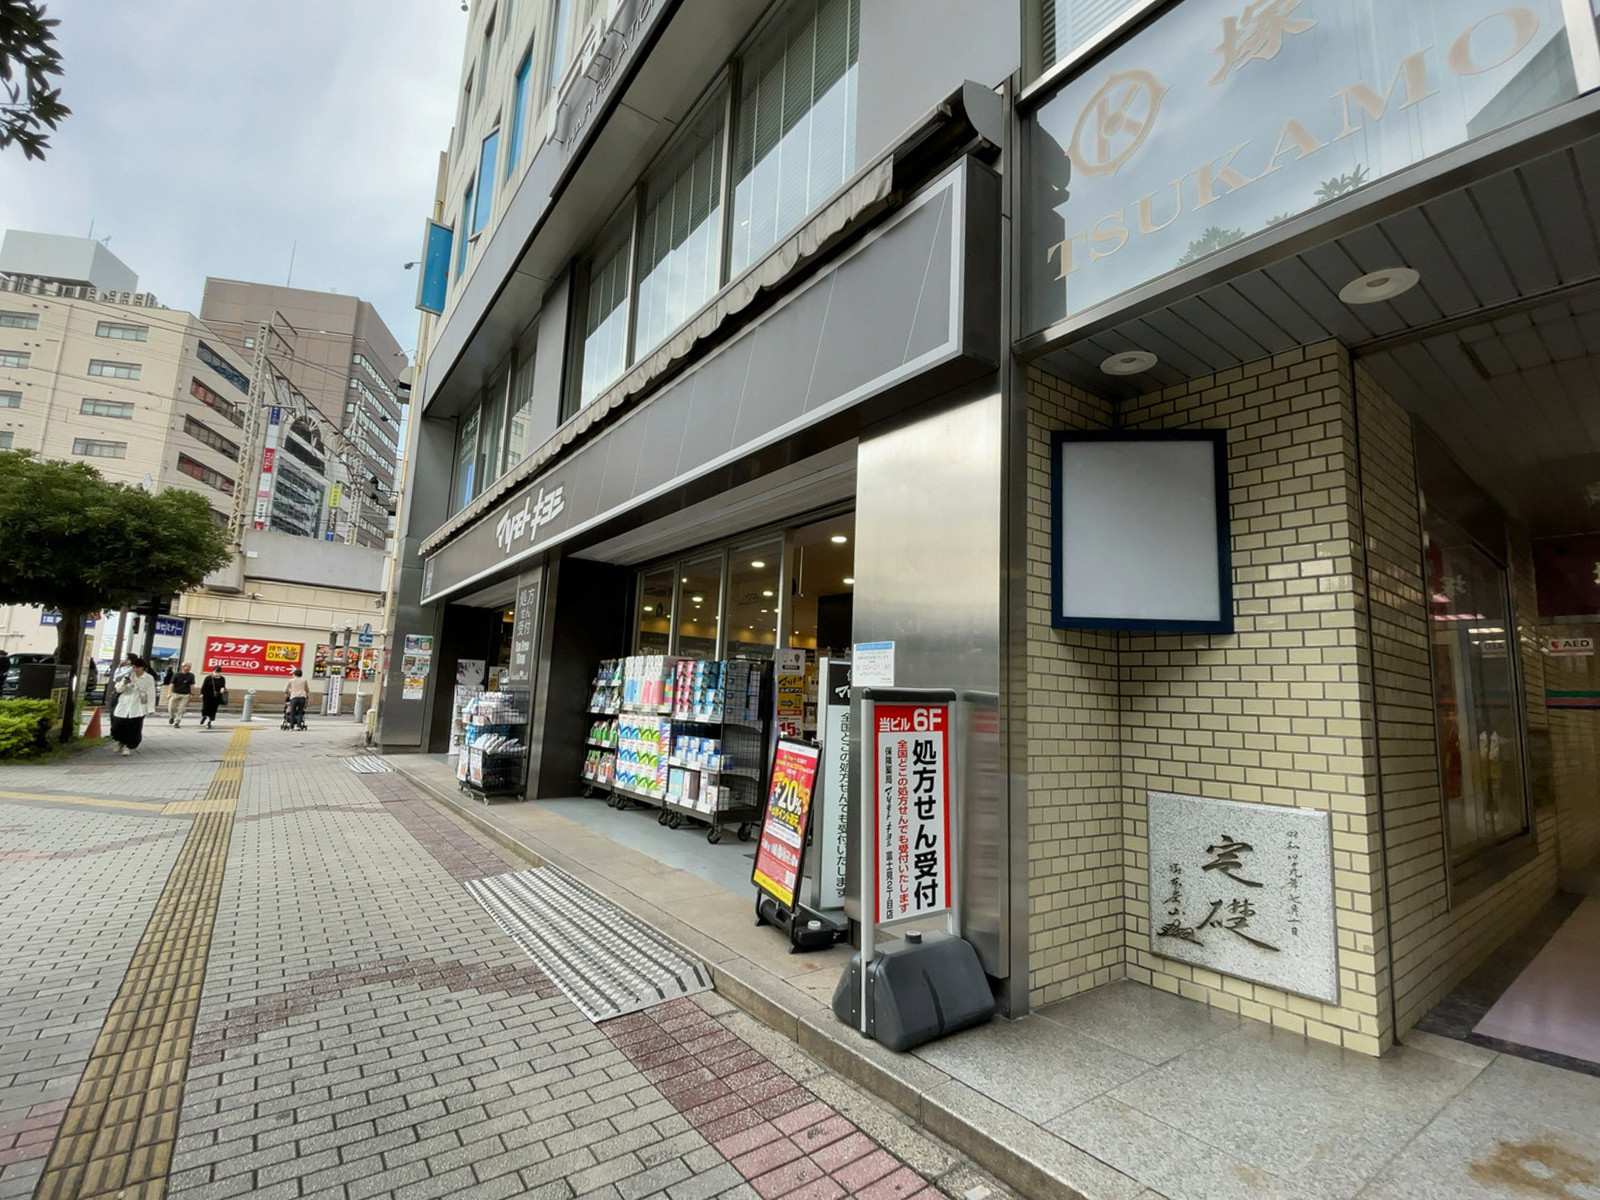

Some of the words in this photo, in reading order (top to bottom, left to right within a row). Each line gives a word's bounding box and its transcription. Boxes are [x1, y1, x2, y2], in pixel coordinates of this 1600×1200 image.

[496, 485, 565, 553] マツモトキヨシ
[209, 641, 264, 654] カラオケ
[1563, 640, 1590, 648] AED
[879, 717, 911, 732] 当ビル
[913, 708, 942, 732] 6F
[912, 739, 938, 910] 処方せん受付
[1196, 834, 1282, 953] 定礎
